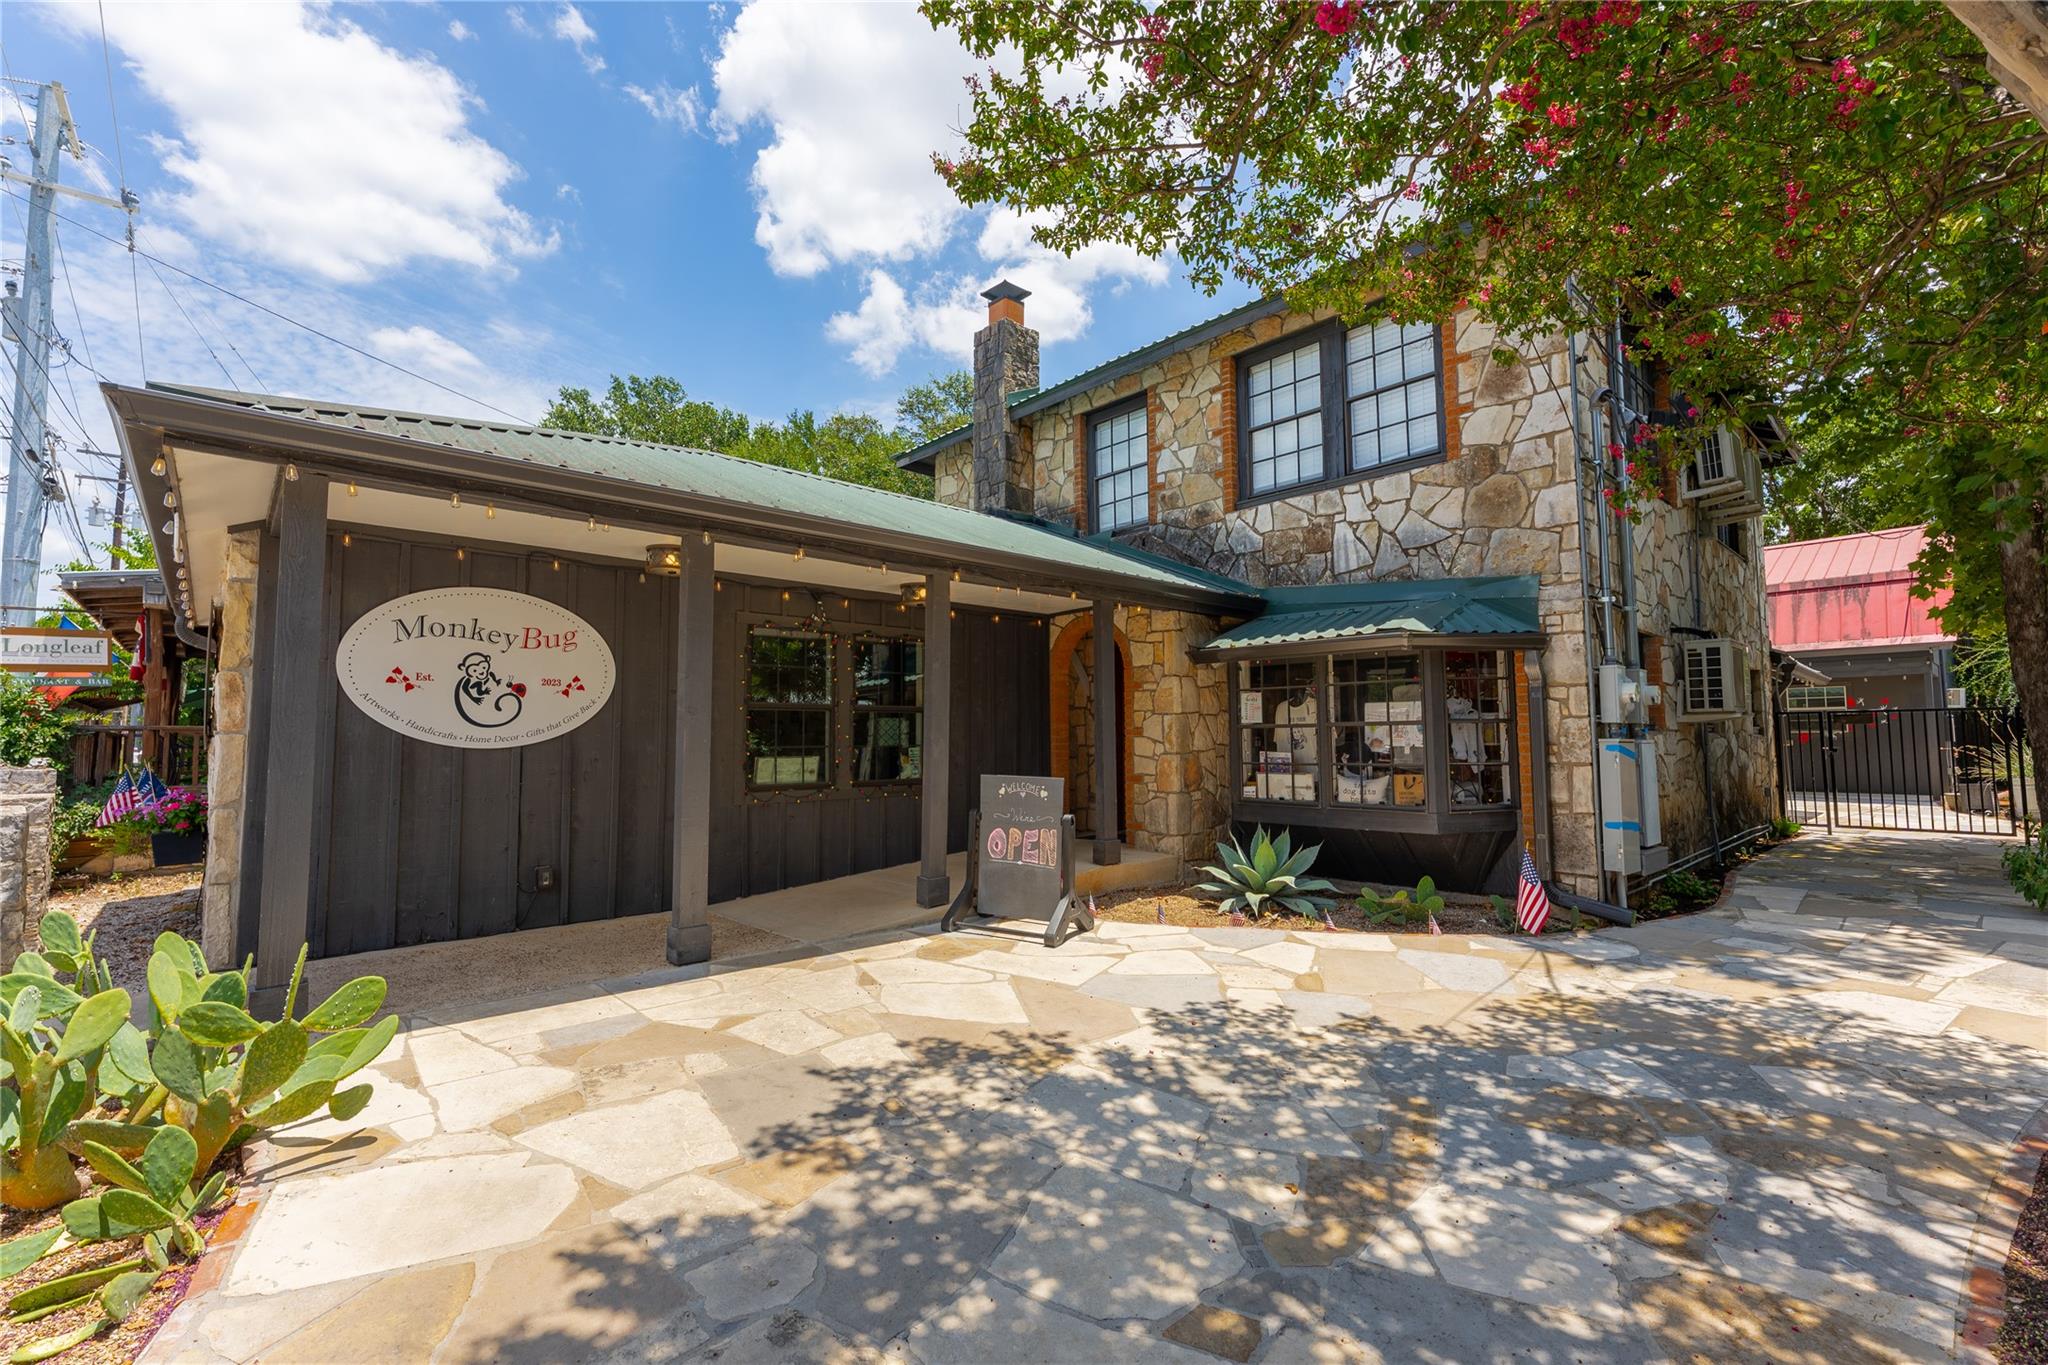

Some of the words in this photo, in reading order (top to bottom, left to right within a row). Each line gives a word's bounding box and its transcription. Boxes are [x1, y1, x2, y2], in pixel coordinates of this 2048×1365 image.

[391, 614, 578, 654] MonkeyBug
[3, 637, 103, 658] Longleaf
[75, 678, 82, 686] &
[88, 677, 109, 686] BAR
[415, 672, 435, 682] Est.
[541, 678, 562, 687] 2023
[360, 692, 400, 721] Artworks
[405, 719, 458, 741] Handicrafts
[464, 734, 492, 743] Home
[494, 734, 519, 743] Decor
[526, 726, 545, 738] Gifts
[546, 721, 562, 732] that
[562, 712, 580, 725] Give
[579, 698, 598, 715] Back
[1005, 781, 1041, 795] WELCOME
[987, 827, 1058, 867] OPEN
